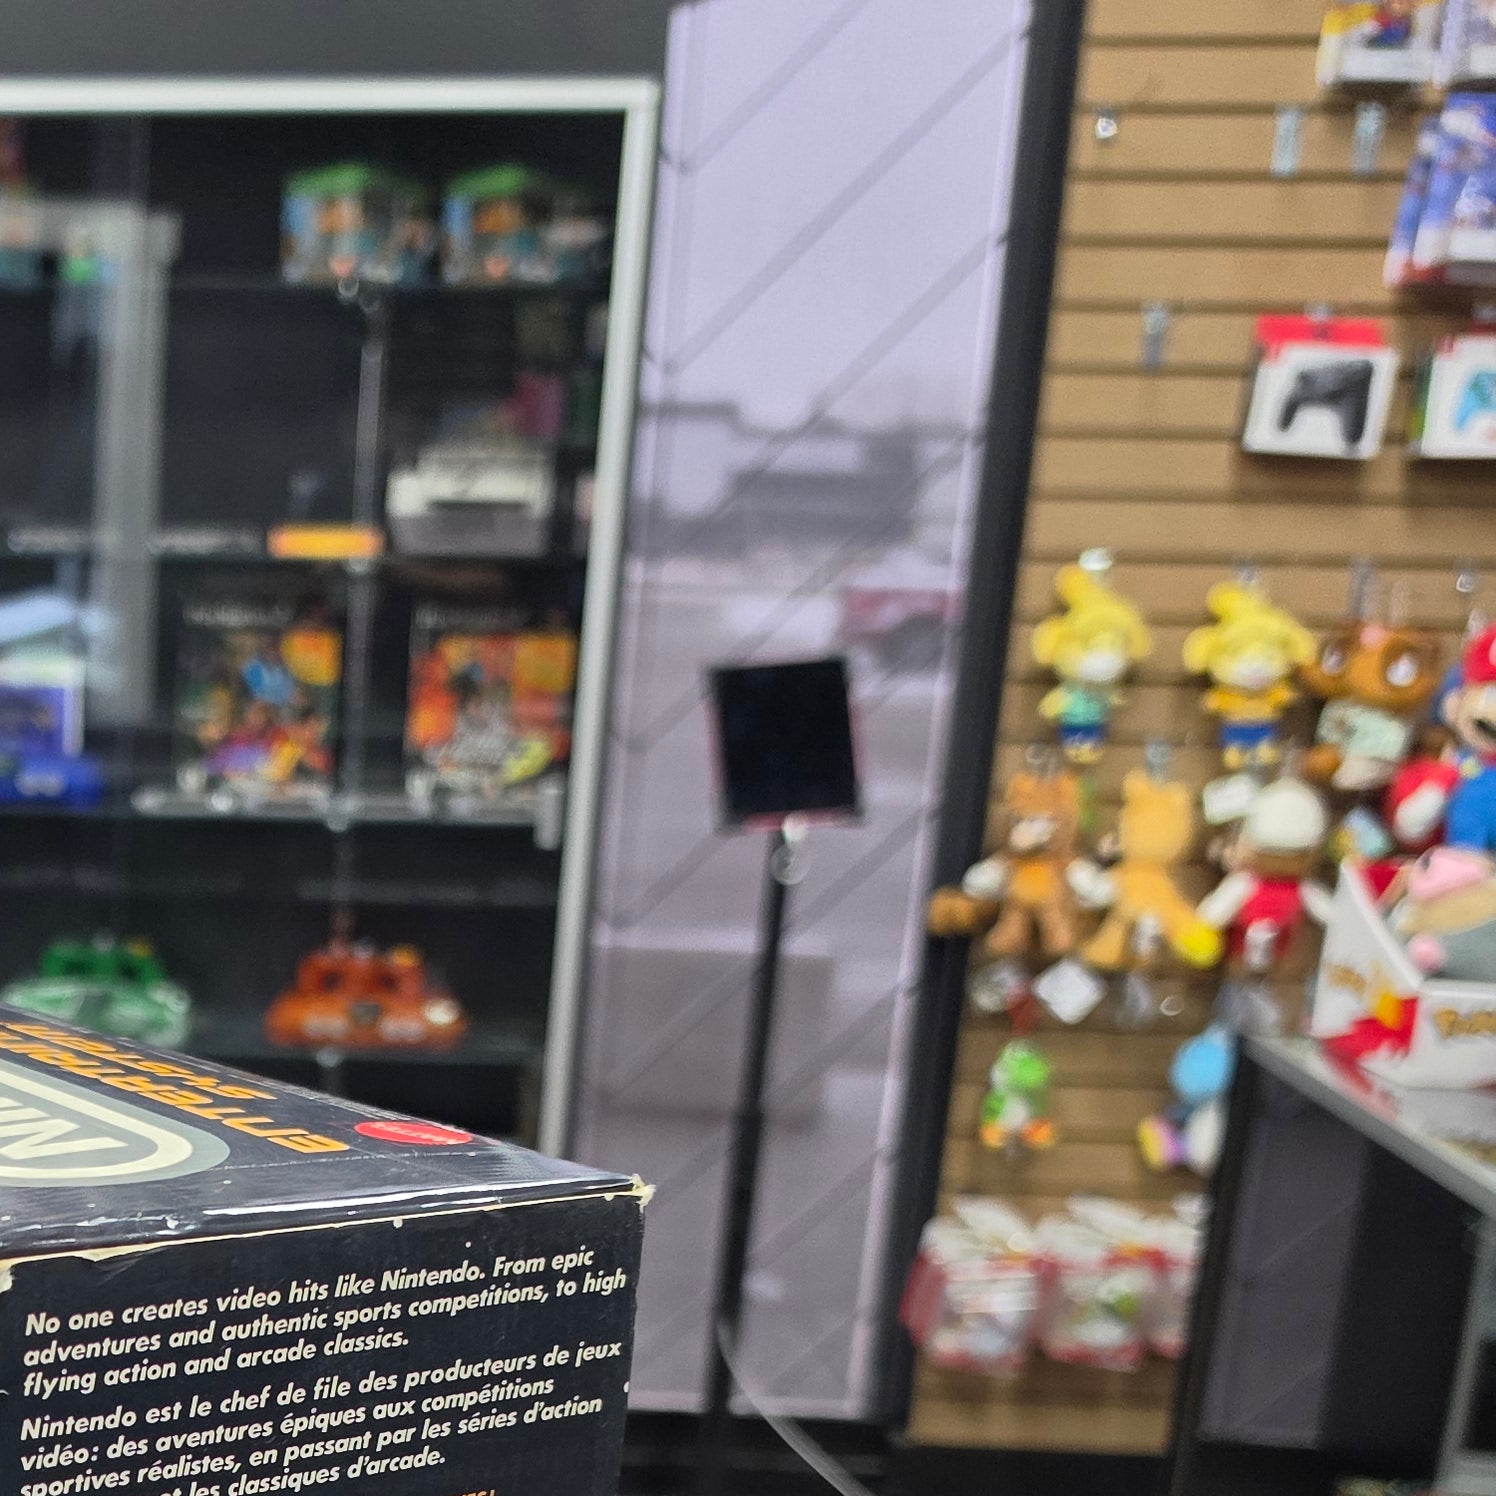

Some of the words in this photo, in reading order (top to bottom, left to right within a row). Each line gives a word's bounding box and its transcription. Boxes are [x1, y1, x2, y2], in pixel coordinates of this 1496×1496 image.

[23, 1334, 161, 1367] adventures
[169, 1320, 216, 1348] and
[221, 1307, 328, 1341] authentic
[333, 1301, 402, 1331] sports
[407, 1282, 549, 1317] competitions,
[555, 1279, 577, 1297] to
[582, 1267, 627, 1296] high
[25, 1312, 61, 1337] No
[68, 1310, 114, 1331] one
[121, 1298, 209, 1324] creates
[216, 1285, 281, 1312] video
[288, 1279, 329, 1304] hits
[334, 1273, 375, 1298] like
[380, 1259, 486, 1292] Nintendo.
[492, 1256, 546, 1278] From
[551, 1244, 595, 1274] epic
[20, 1405, 137, 1441] Nintendo
[145, 1401, 183, 1424] est
[188, 1395, 212, 1418] le
[219, 1385, 272, 1414] chef
[276, 1381, 307, 1406] de
[313, 1375, 351, 1400] file
[358, 1370, 398, 1394] des
[403, 1354, 537, 1393] producteurs
[542, 1344, 570, 1367] de
[574, 1341, 622, 1368] jeux
[23, 1368, 97, 1400] flying
[103, 1358, 177, 1386] action
[184, 1347, 232, 1376] and
[236, 1338, 317, 1368] arcade
[323, 1326, 409, 1356] classics.
[20, 1443, 99, 1471] vidéo:
[106, 1434, 148, 1459] des
[155, 1421, 274, 1453] aventures
[280, 1406, 367, 1438] épiques
[372, 1400, 416, 1420] aux
[421, 1377, 555, 1413] compétitions
[136, 1454, 242, 1483] réalistes,
[249, 1448, 278, 1467] en
[282, 1431, 372, 1467] passant
[375, 1427, 417, 1452] par
[420, 1417, 452, 1440] les
[457, 1407, 518, 1434] séries
[523, 1395, 603, 1424] d'action
[347, 1445, 446, 1479] d'arcade.
